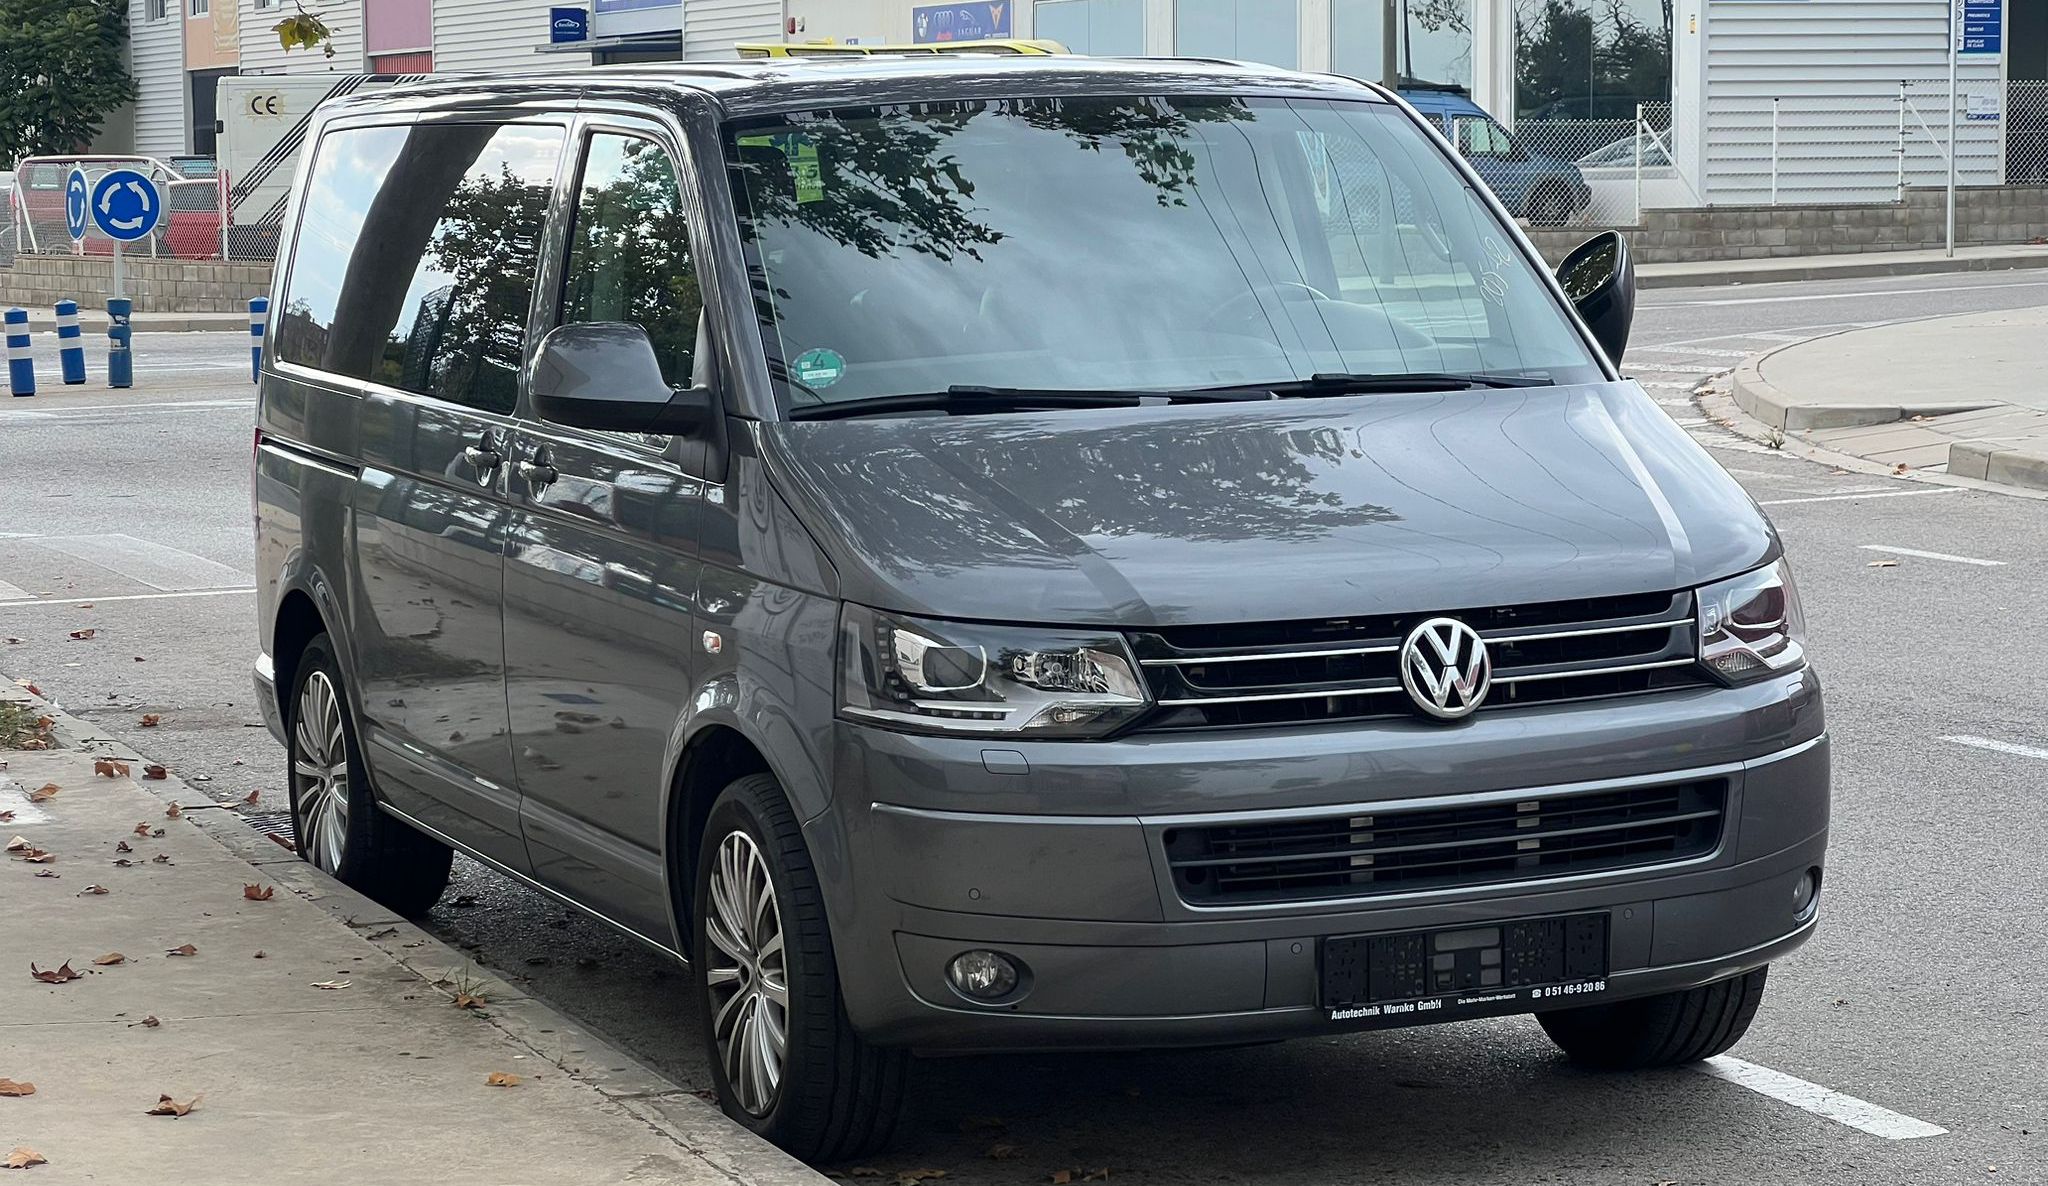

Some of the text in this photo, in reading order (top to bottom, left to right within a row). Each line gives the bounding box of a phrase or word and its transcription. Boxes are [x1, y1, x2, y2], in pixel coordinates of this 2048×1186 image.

[251, 96, 278, 115] CE
[812, 353, 825, 368] 4
[1545, 980, 1606, 997] 0 51 46-9 20 86
[1331, 999, 1443, 1020] Autotechnik Warnke GmbH
